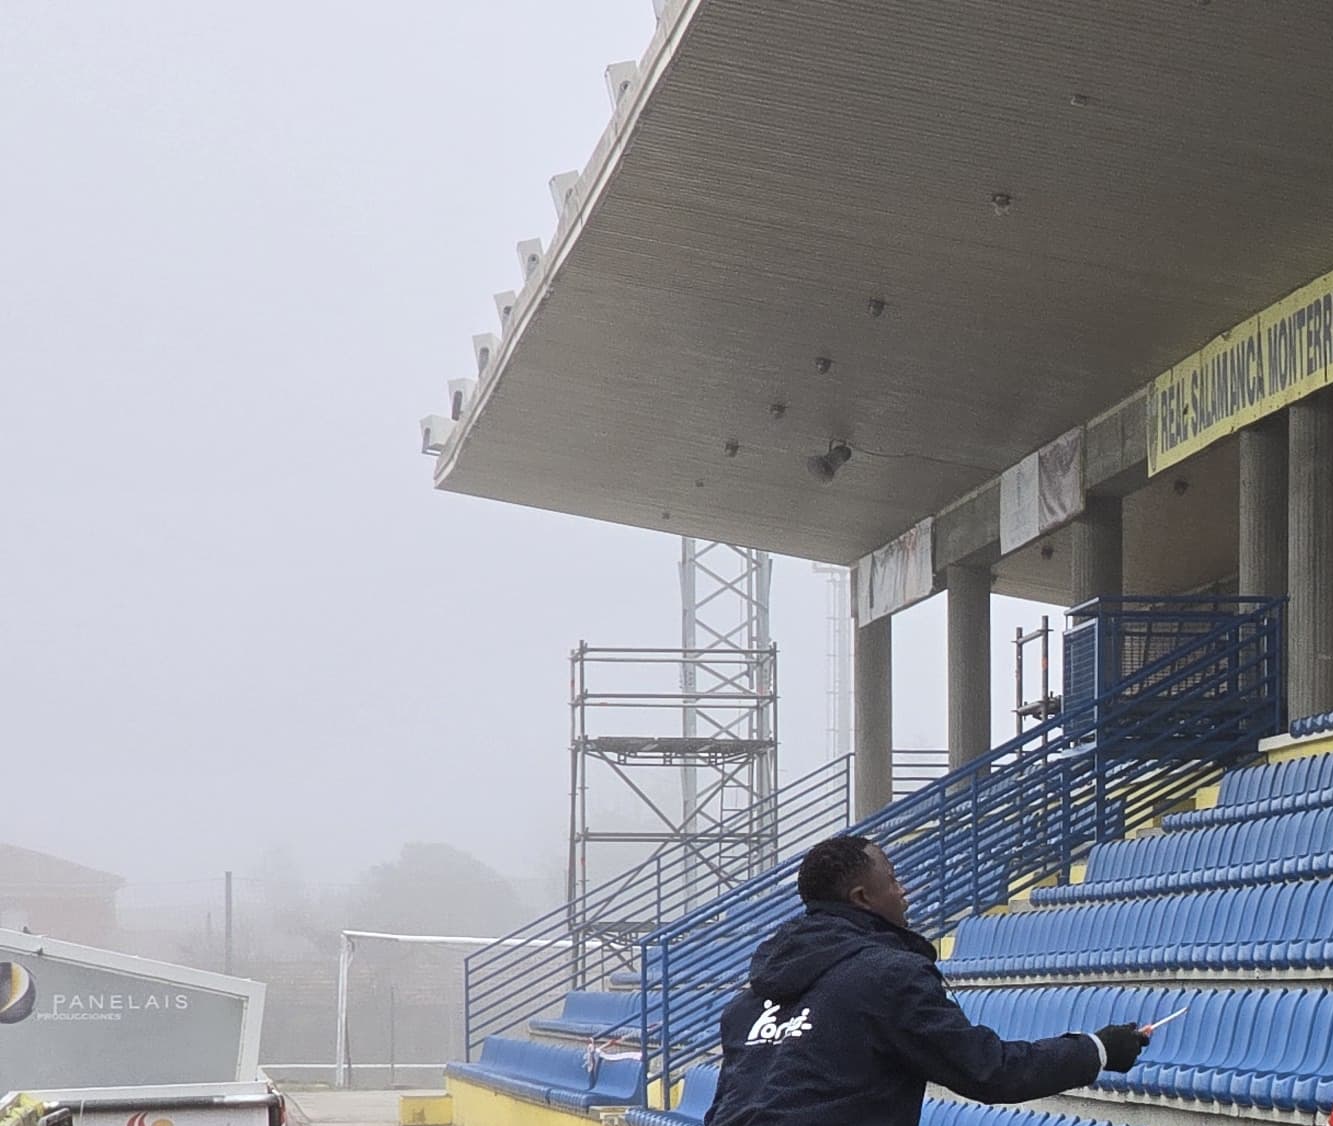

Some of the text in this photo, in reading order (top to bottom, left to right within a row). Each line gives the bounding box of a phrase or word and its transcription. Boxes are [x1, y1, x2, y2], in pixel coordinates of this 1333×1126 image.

[1161, 377, 1188, 454] REAL
[1191, 332, 1265, 438] SALAMANCA
[53, 993, 189, 1013] PANELAIS
